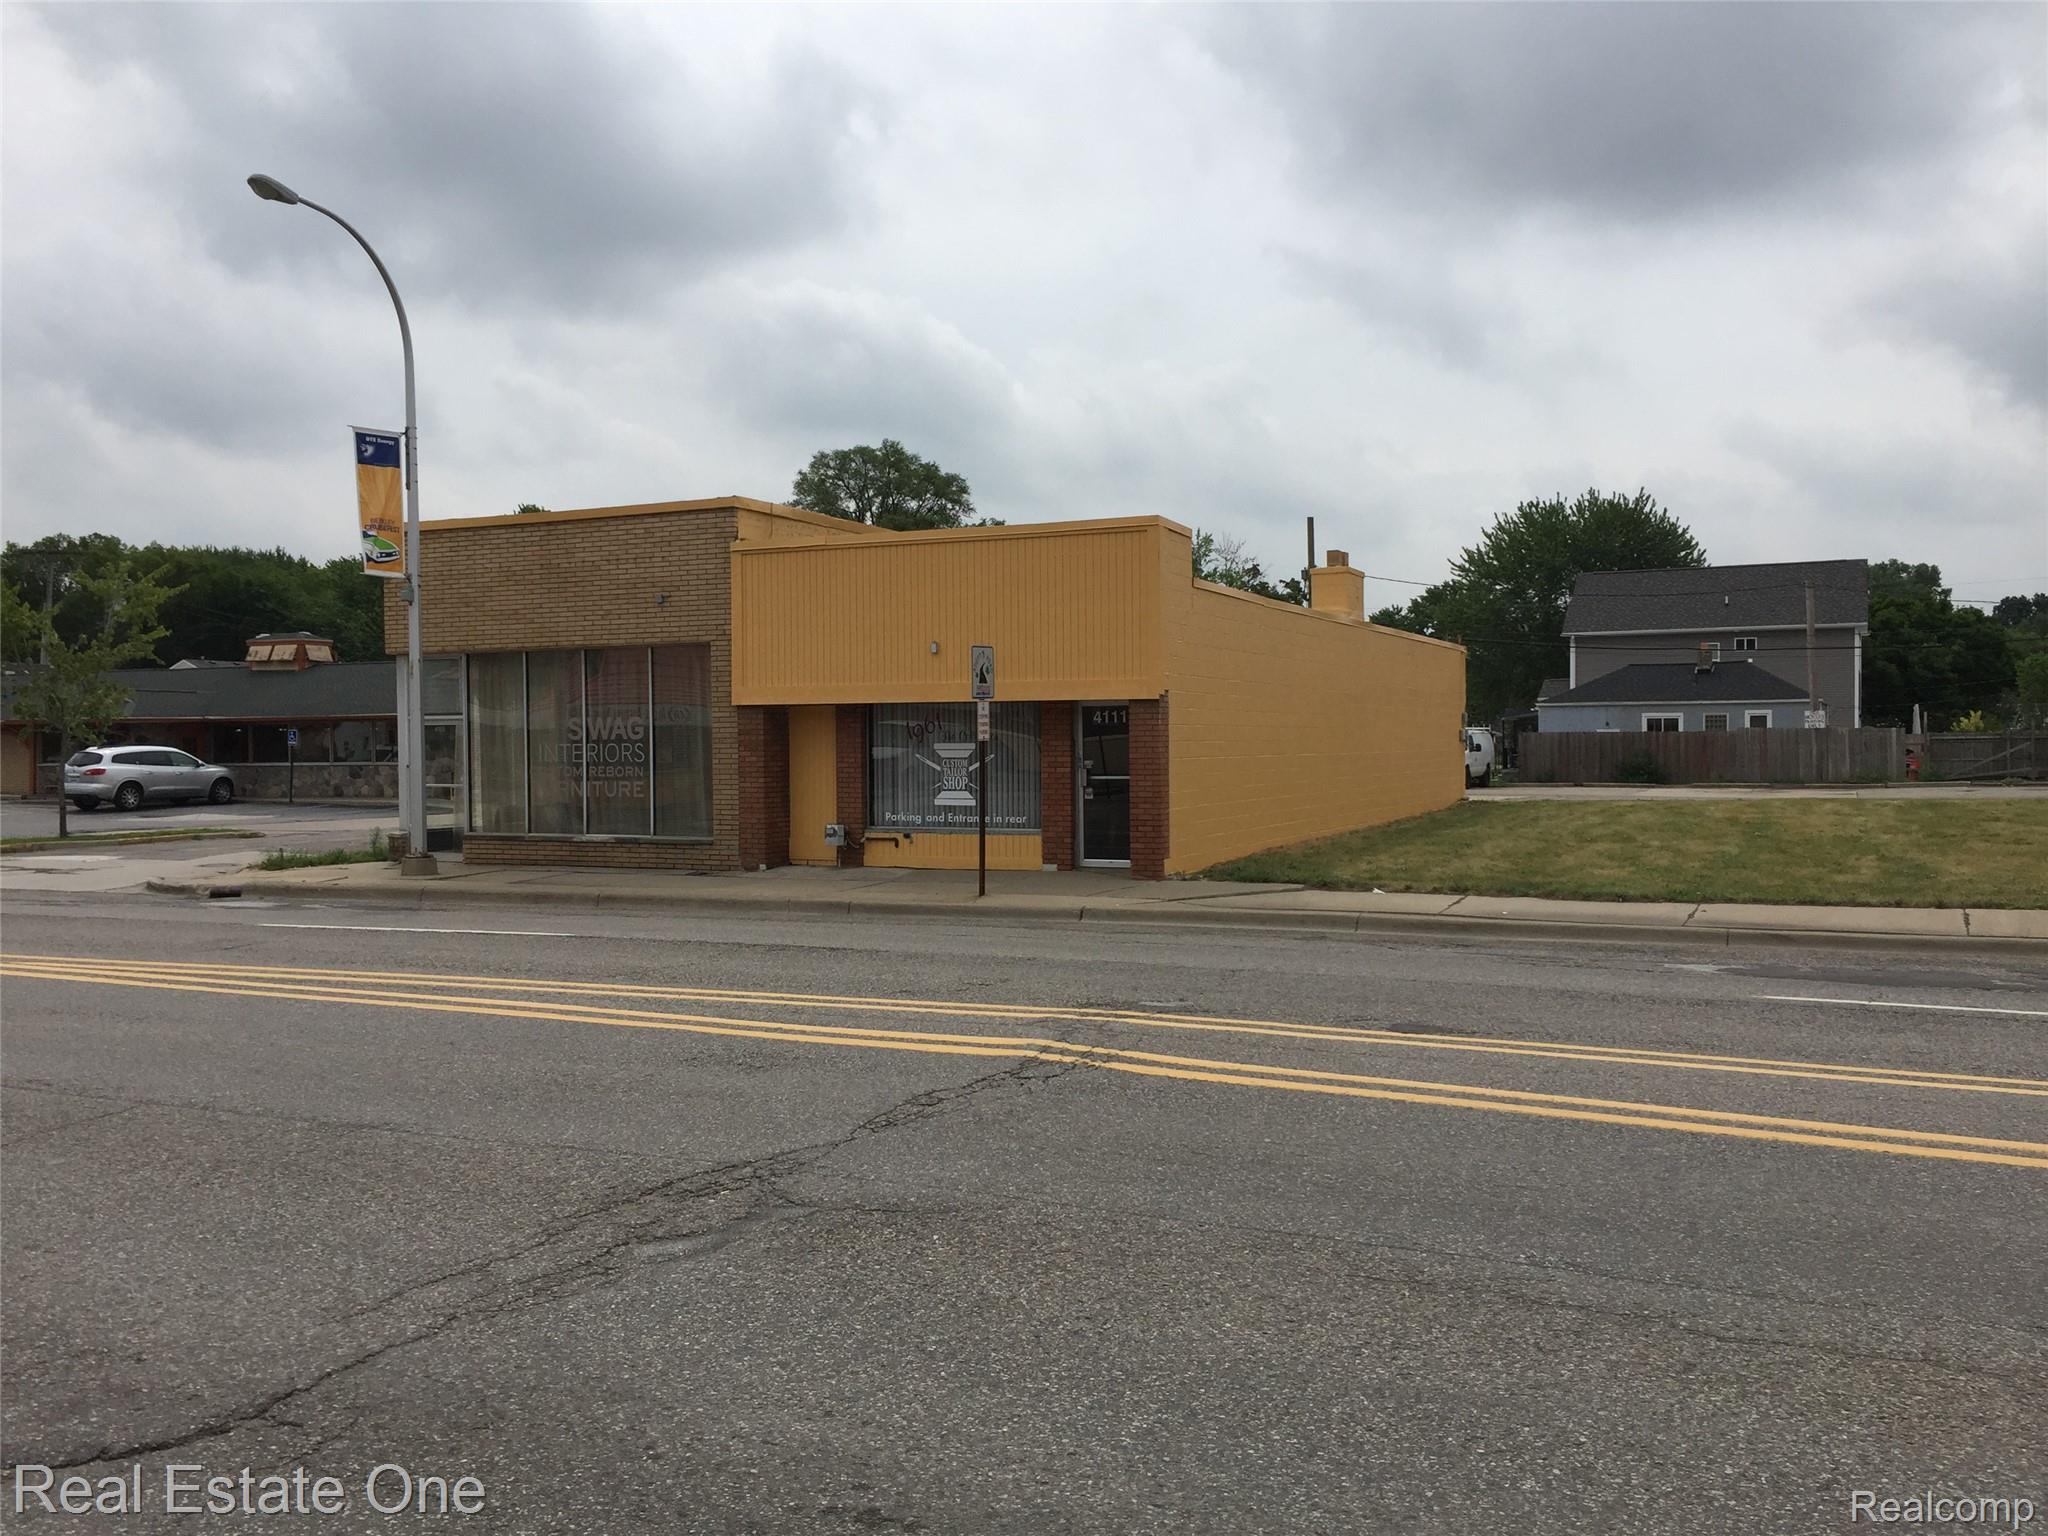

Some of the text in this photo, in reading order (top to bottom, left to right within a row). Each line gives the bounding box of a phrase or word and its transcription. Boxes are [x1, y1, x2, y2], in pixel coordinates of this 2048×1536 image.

[1093, 710, 1127, 724] 4111
[567, 716, 646, 741] SWAG
[538, 743, 646, 764] INTERIORS
[942, 759, 968, 768] CUSTOM
[588, 766, 644, 777] REBORN
[942, 767, 968, 777] TAILOR
[559, 780, 645, 798] RNITURE
[942, 776, 969, 790] SHOP
[885, 812, 1027, 825] Parking and Entrane in rear
